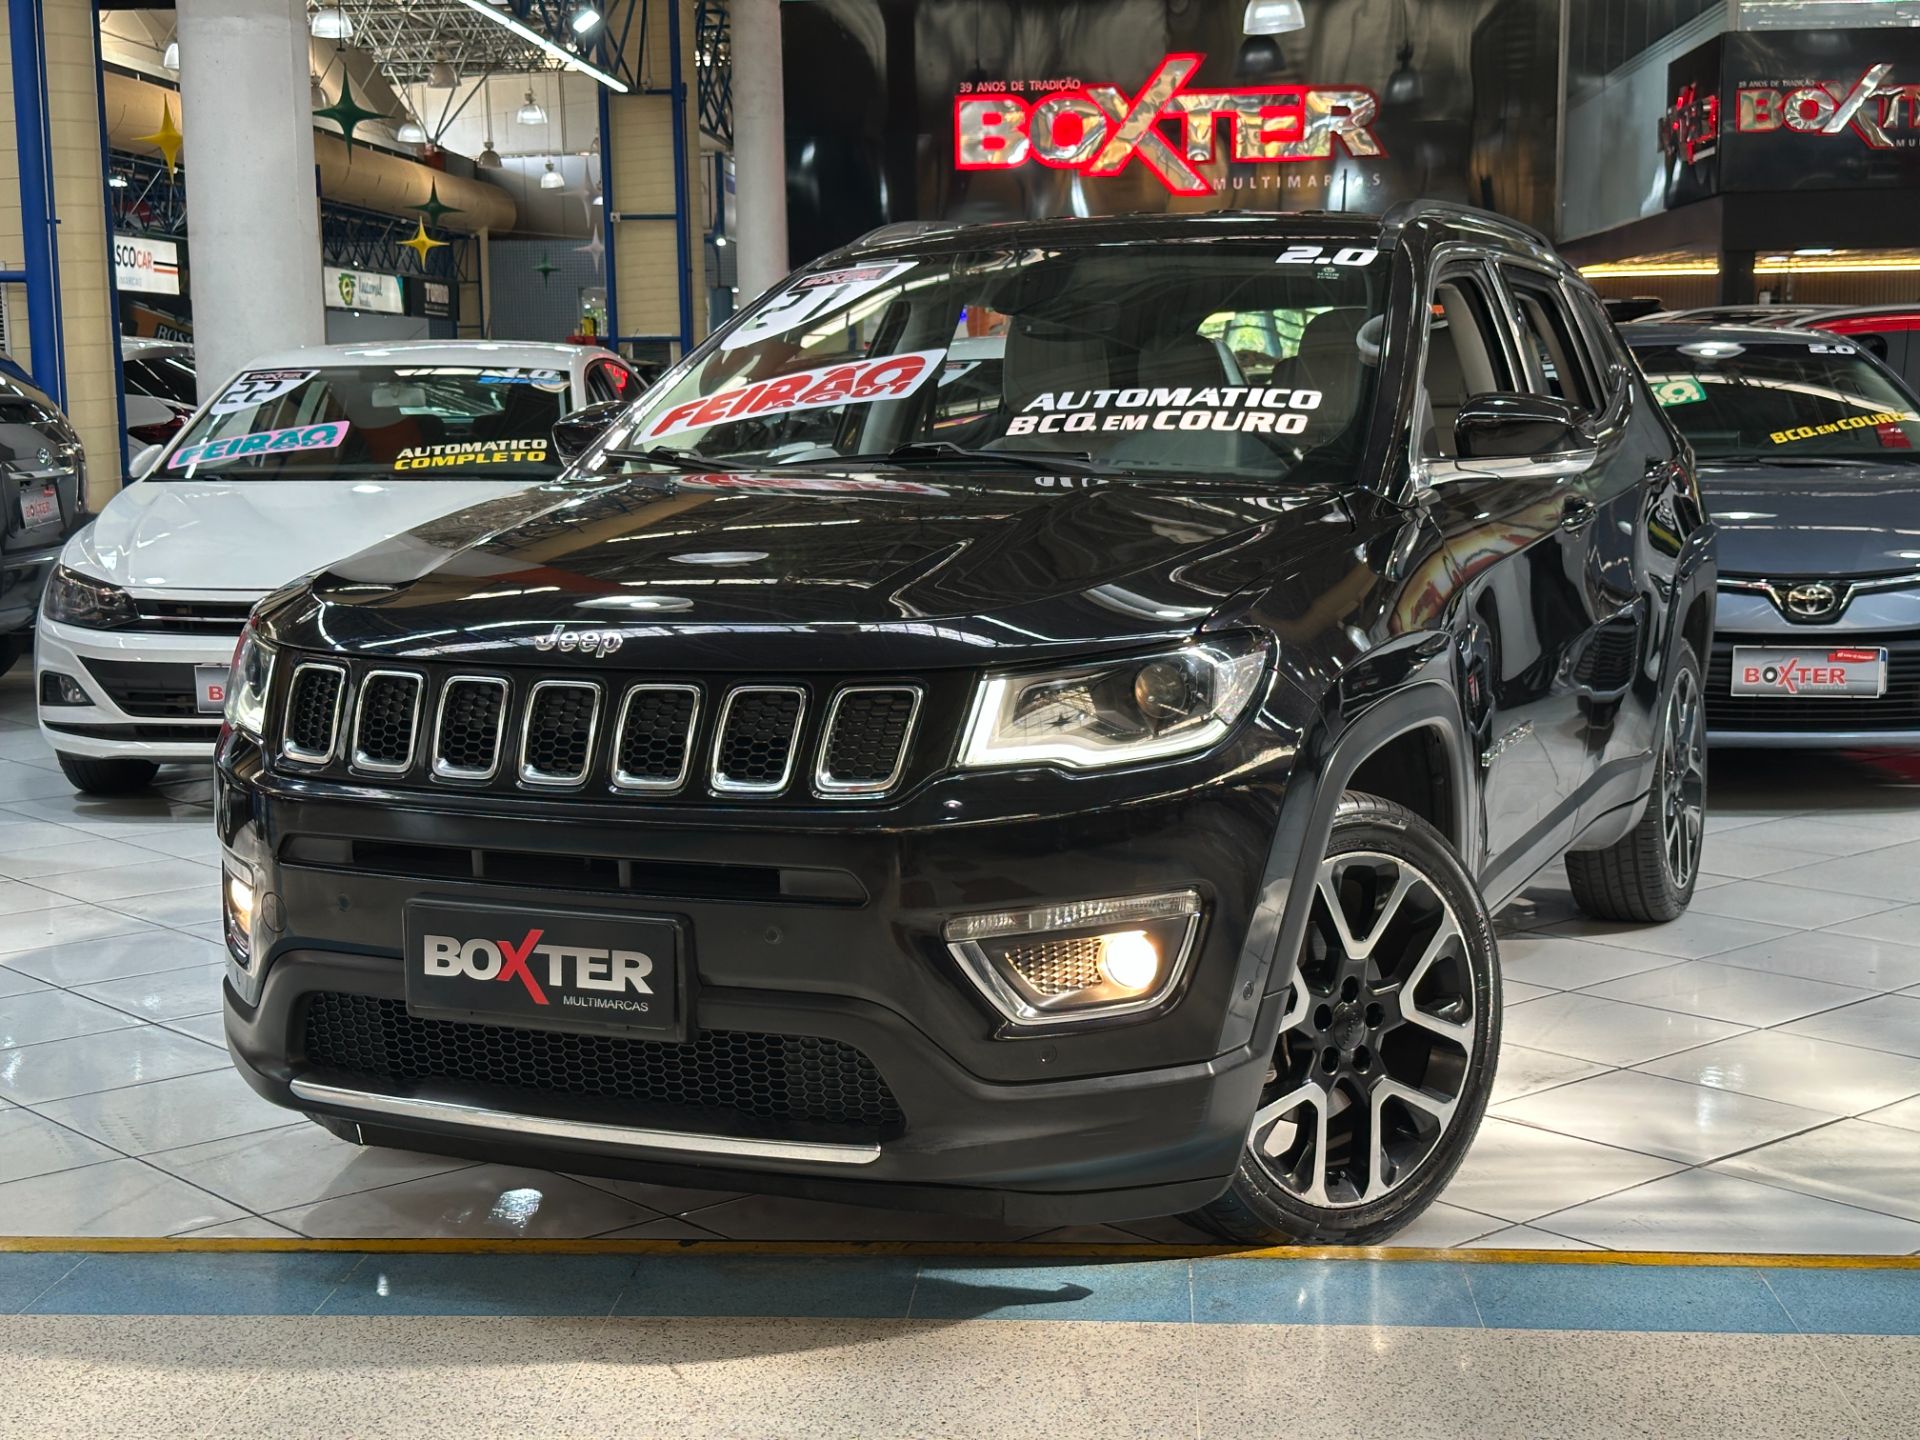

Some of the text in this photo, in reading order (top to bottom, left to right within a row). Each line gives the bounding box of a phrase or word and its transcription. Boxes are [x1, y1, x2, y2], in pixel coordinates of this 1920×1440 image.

[959, 77, 1081, 93] 39 ANOS DE TRADIÇÃO
[955, 53, 1388, 196] BOXTER
[1275, 246, 1379, 266] 2.0
[1808, 344, 1856, 355] 2.0
[249, 371, 303, 381] BOXTER
[218, 381, 283, 404] 22
[1101, 414, 1149, 431] EM
[1152, 410, 1308, 434] COURO
[1816, 422, 1840, 435] EM
[394, 450, 547, 470] COMPLETO
[534, 624, 624, 658] Jeep
[1743, 656, 1847, 695] BOXTER
[423, 928, 655, 1006] BOXTER
[562, 995, 649, 1012] MULTIMARCAS
